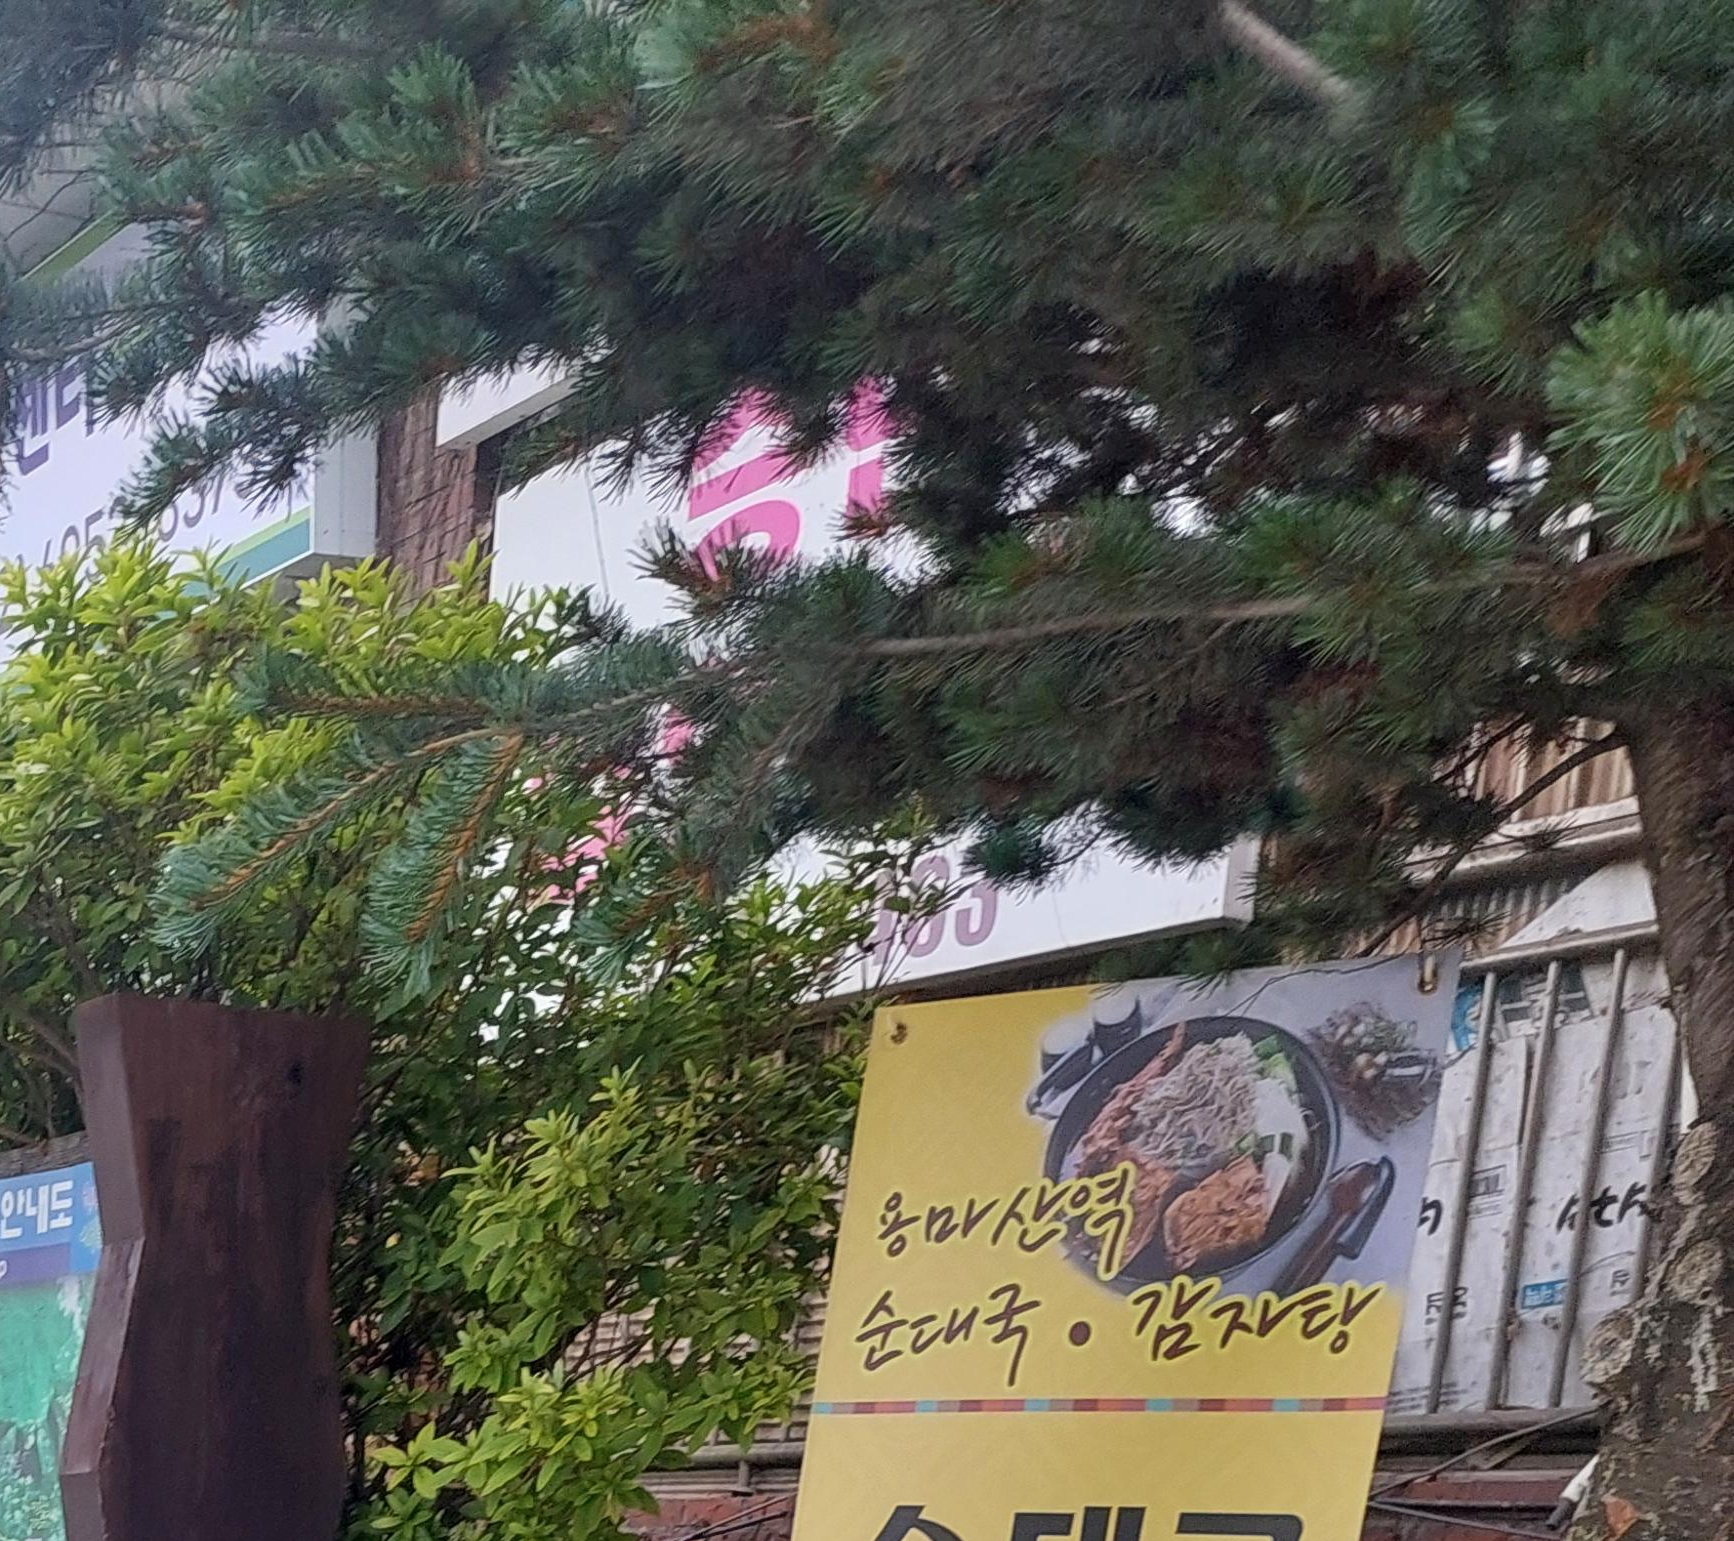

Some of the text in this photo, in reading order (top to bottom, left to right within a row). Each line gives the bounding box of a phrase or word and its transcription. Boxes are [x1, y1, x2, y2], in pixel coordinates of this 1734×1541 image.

[0, 1179, 74, 1241] 안내도
[873, 1165, 1134, 1276] 용마산역
[853, 1281, 1041, 1388] 순대국
[1131, 1280, 1382, 1361] 감자탕
